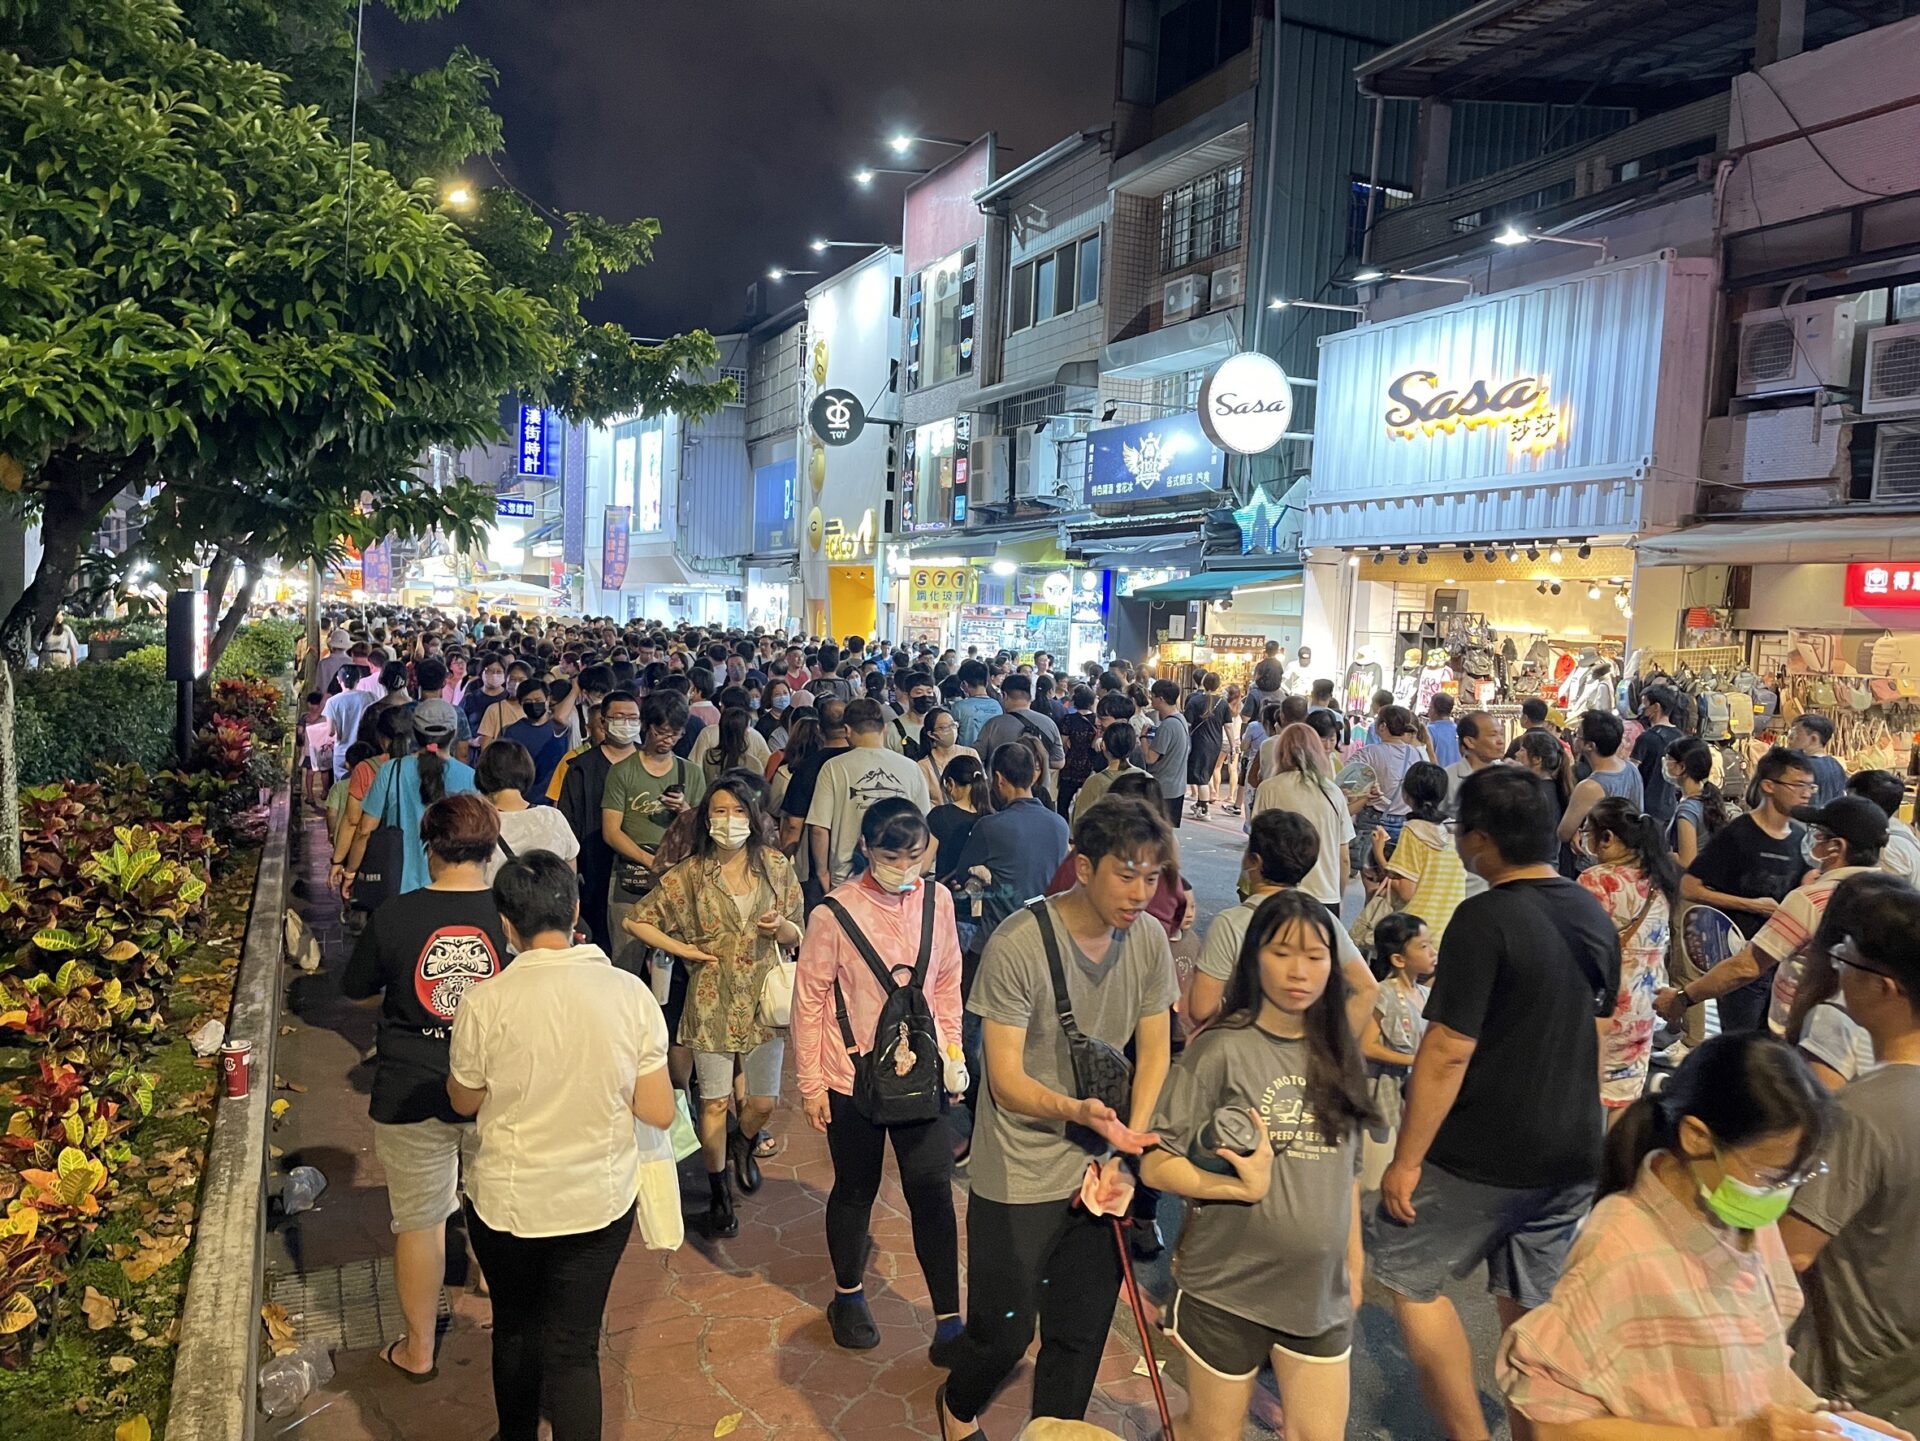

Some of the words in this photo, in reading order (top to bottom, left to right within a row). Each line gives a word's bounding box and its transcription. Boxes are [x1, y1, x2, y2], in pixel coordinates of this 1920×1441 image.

[1215, 392, 1286, 416] Sasa
[1385, 371, 1539, 427] Sasa
[1511, 412, 1557, 442] 莎莎
